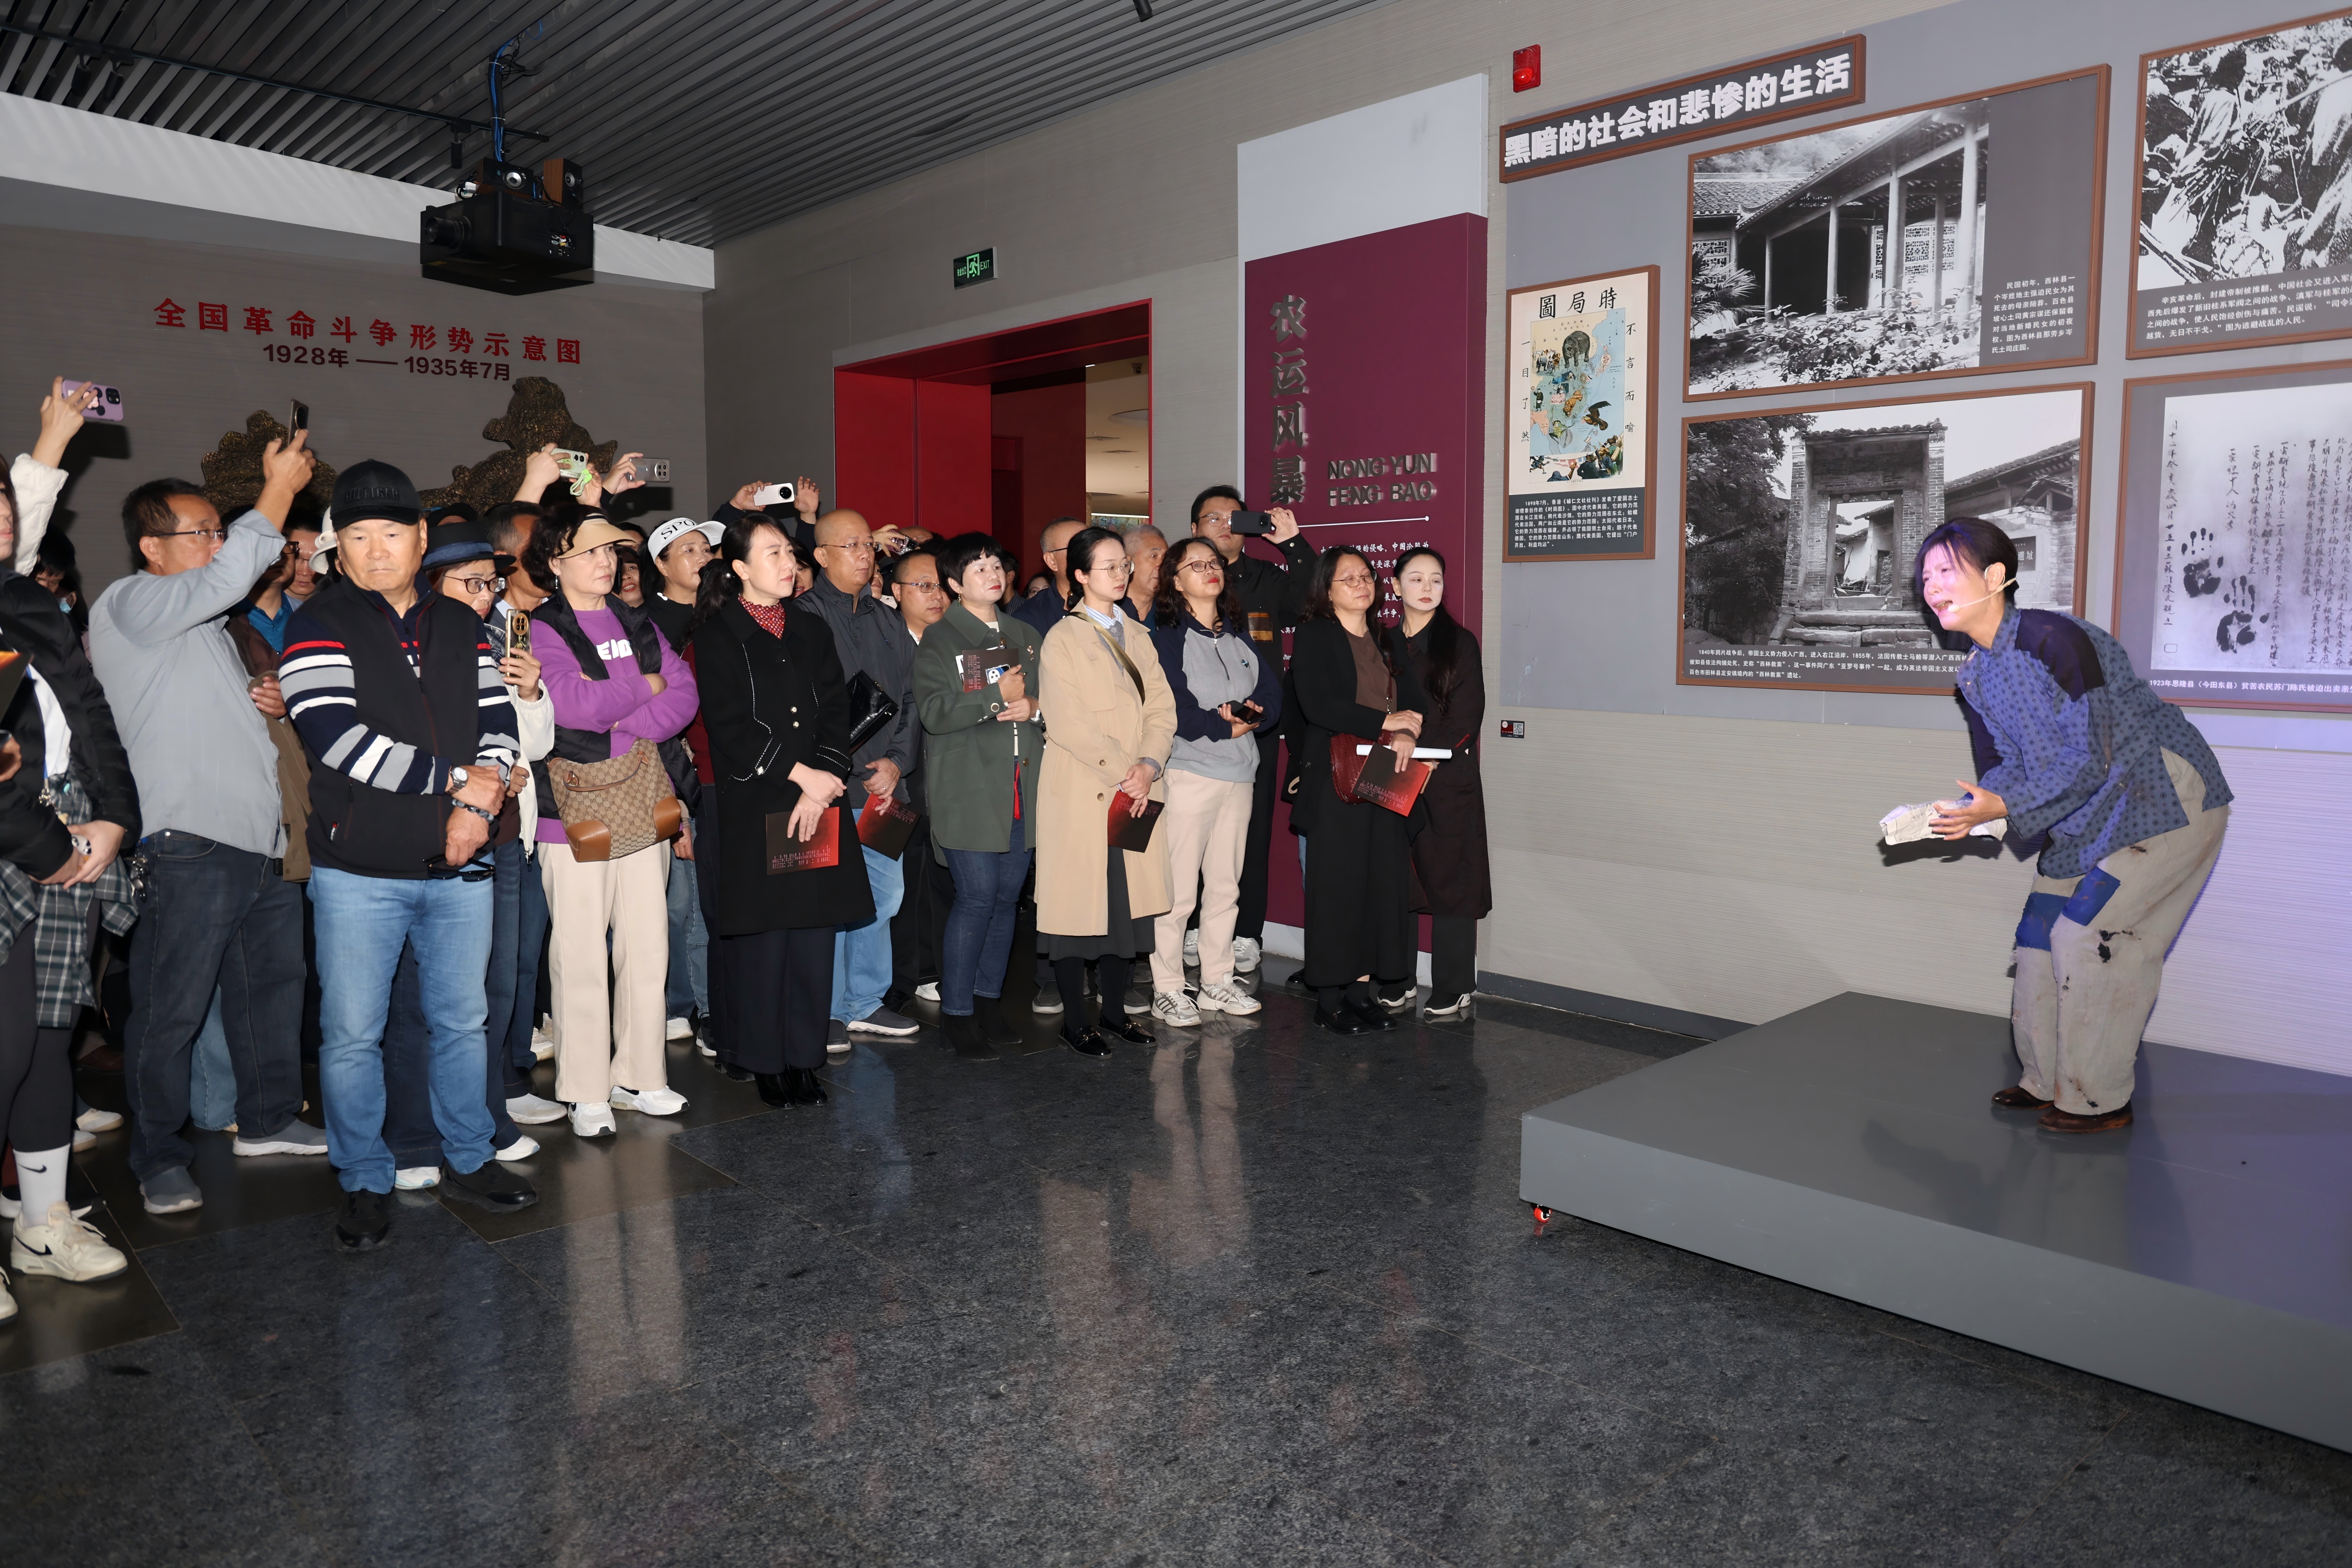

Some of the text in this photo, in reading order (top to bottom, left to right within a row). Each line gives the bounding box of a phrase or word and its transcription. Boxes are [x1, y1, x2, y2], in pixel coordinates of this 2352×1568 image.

[1504, 53, 1851, 167] 黑暗的社会和悲惨的生活
[980, 260, 990, 270] EXIT
[154, 298, 580, 364] 全国革命斗争形势示意图
[2147, 286, 2352, 317] 西先后爆发了新旧桂系军阀之间的战争、滇军与桂军的
[1270, 294, 1308, 505] 农运风暴
[1521, 341, 1531, 443] 一目了然
[1624, 323, 1637, 433] 不言而喻
[1327, 453, 1437, 480] NONG YUN
[1328, 481, 1437, 507] FENG BAO
